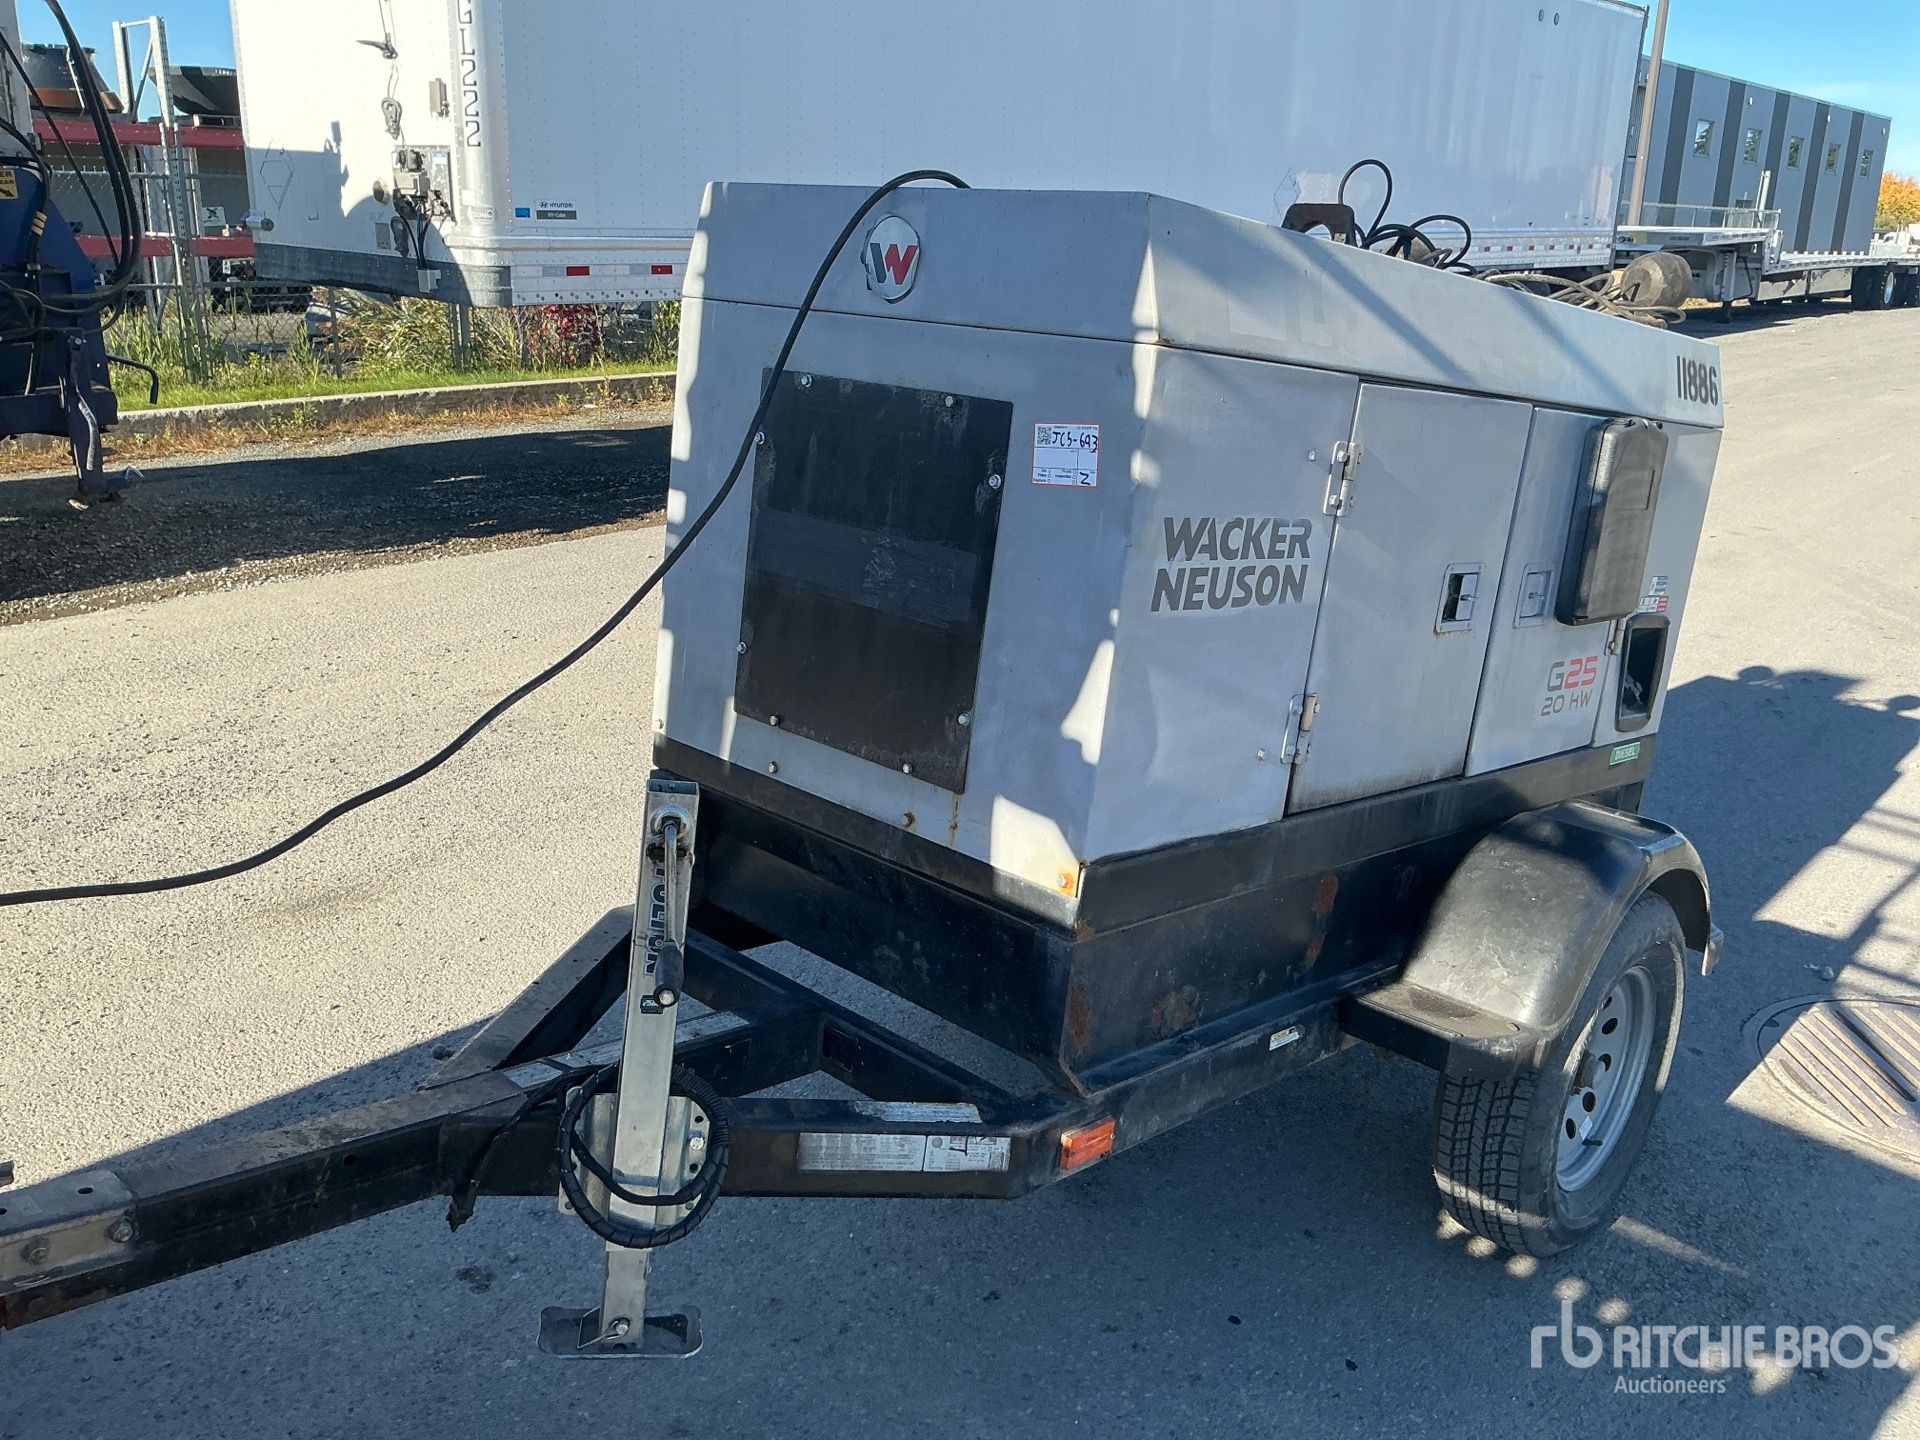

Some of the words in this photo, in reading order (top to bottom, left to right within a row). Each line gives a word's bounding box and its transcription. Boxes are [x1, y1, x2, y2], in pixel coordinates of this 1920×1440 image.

[869, 242, 919, 286] W
[1676, 355, 1718, 406] 11886
[1163, 516, 1312, 562] WACKER
[1151, 564, 1309, 612] NEUSON
[1547, 656, 1598, 692] G25
[1540, 694, 1565, 717] 20
[1614, 746, 1636, 761] DIESEL
